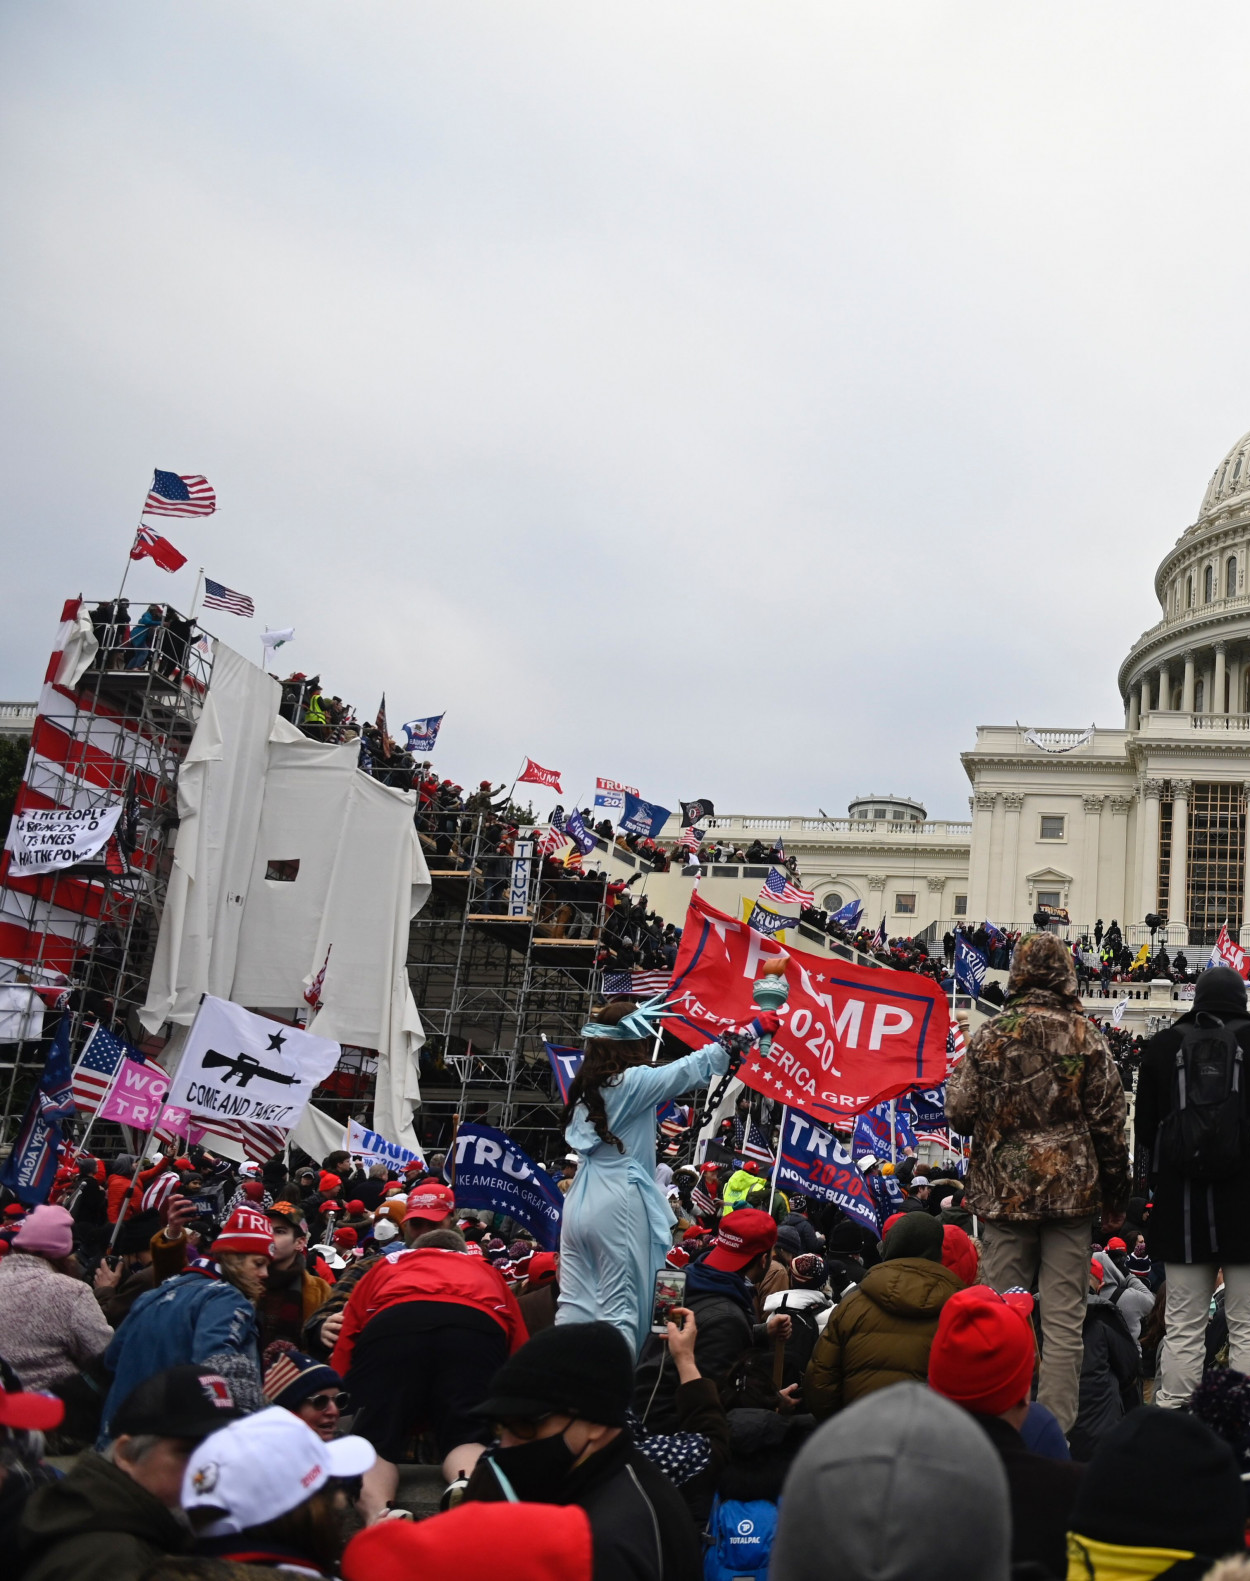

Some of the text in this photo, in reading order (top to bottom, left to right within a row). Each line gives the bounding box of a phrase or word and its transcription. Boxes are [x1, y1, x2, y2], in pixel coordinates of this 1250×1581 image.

[511, 843, 529, 917] TRUMP
[186, 1082, 294, 1121] COME AND TAKE IT
[821, 1090, 870, 1108] GRE
[780, 1167, 800, 1181] NO
[808, 1158, 863, 1197] 2020
[472, 1175, 520, 1196] AMERICA
[521, 1189, 547, 1211] GREAT
[237, 1212, 273, 1235] TRU
[729, 1536, 761, 1545] TOTALPAC
